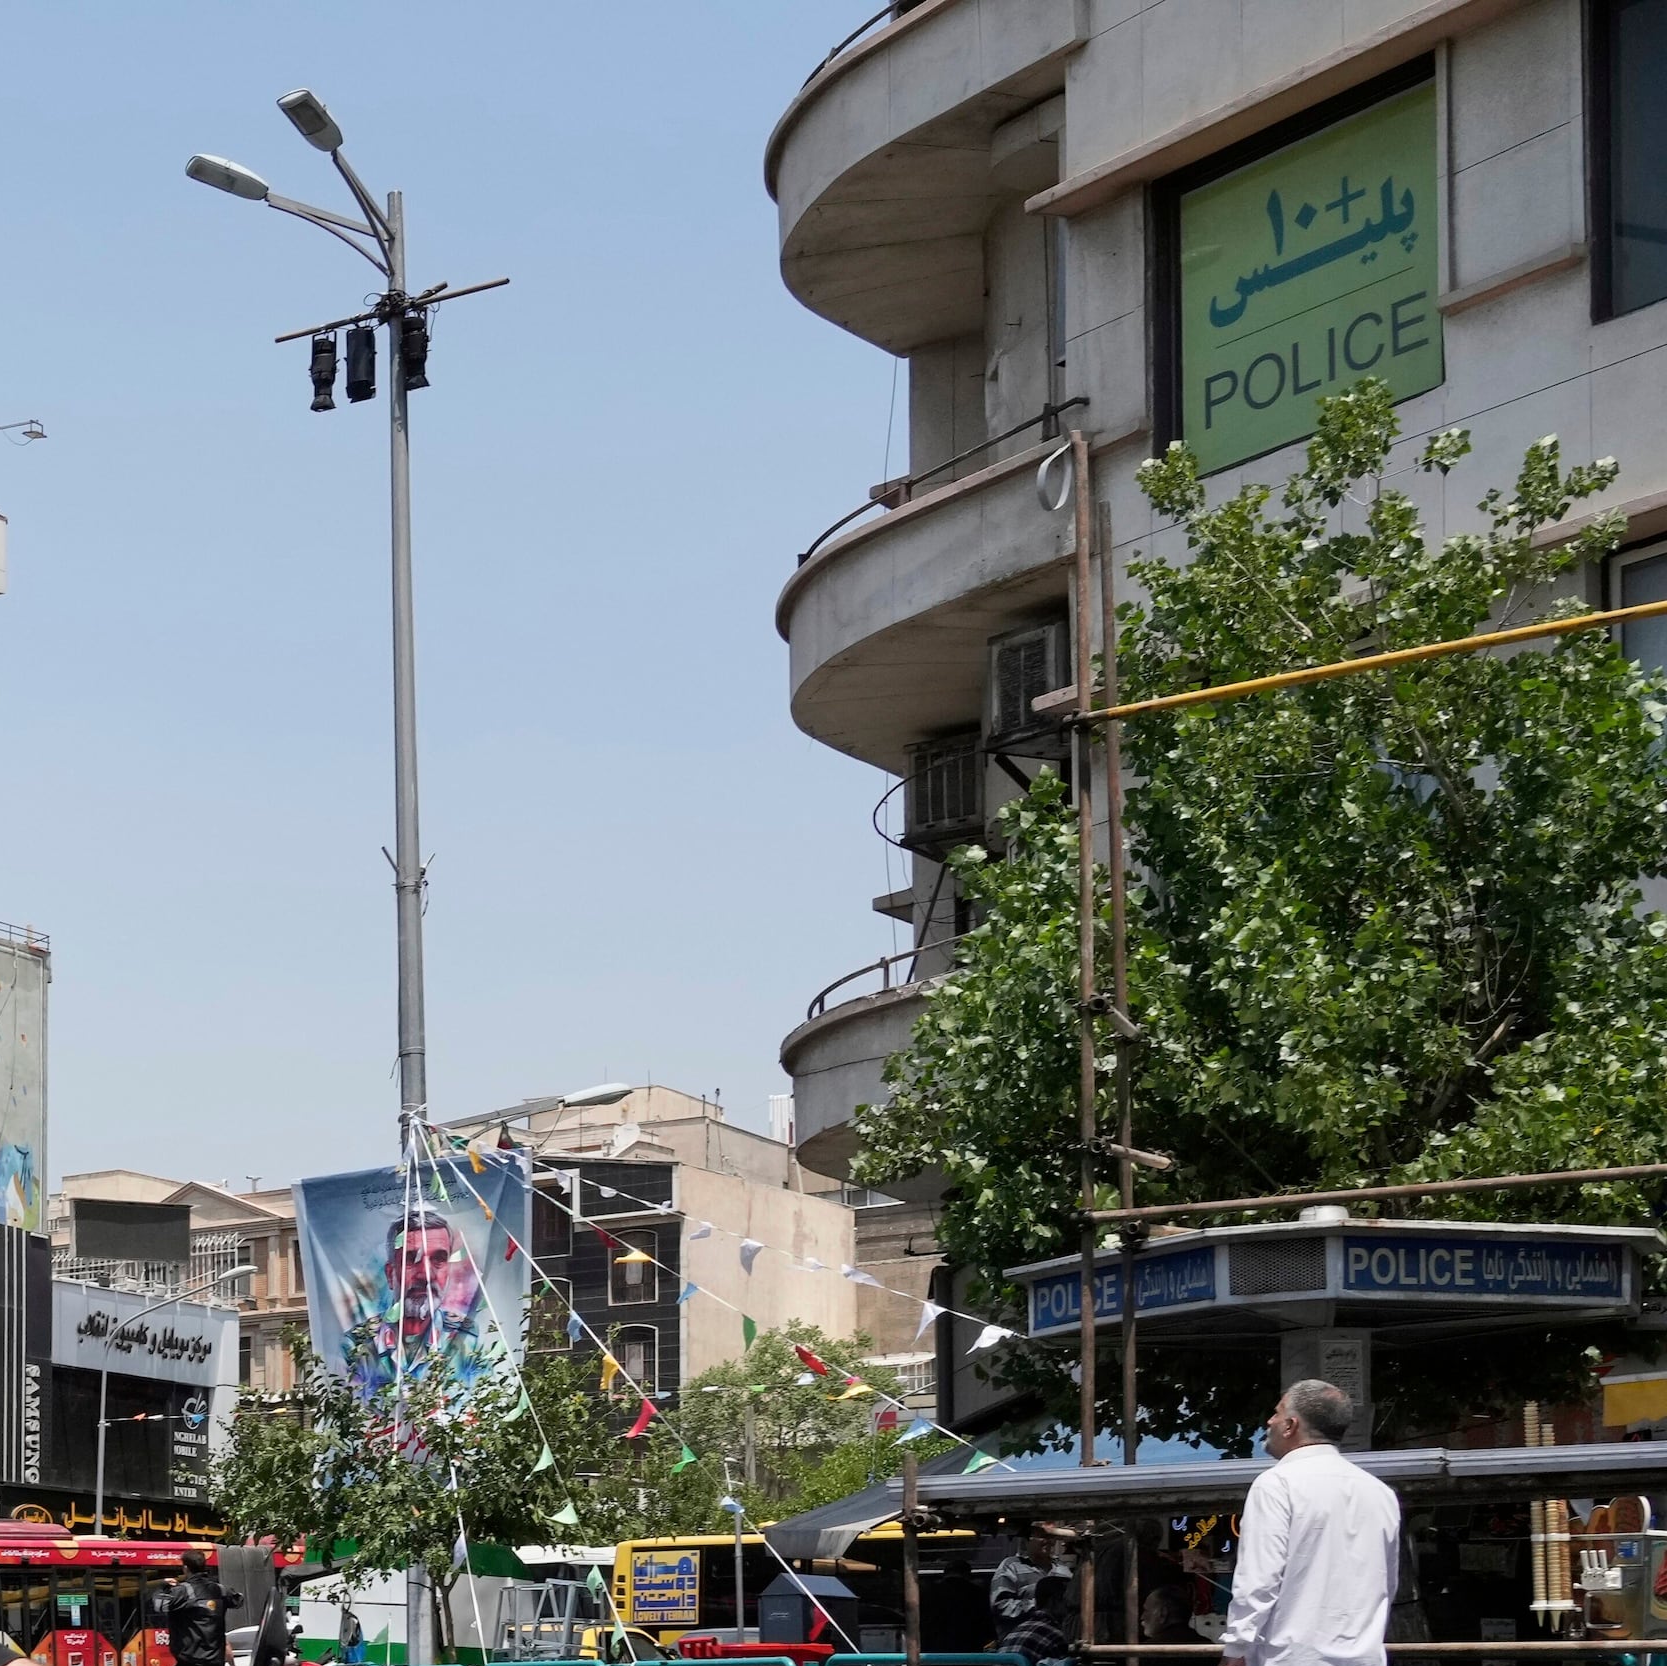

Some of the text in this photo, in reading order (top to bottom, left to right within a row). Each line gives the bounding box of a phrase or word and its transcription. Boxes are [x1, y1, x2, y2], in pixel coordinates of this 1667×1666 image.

[1209, 175, 1415, 328] پلیس
[1204, 291, 1430, 430] POLICE
[1037, 1274, 1117, 1321] POLCE
[1348, 1246, 1475, 1286] POLICE
[1481, 1246, 1618, 1292] راهنمایی و رانندگی ناجا
[25, 1363, 40, 1484] SAMSUNG
